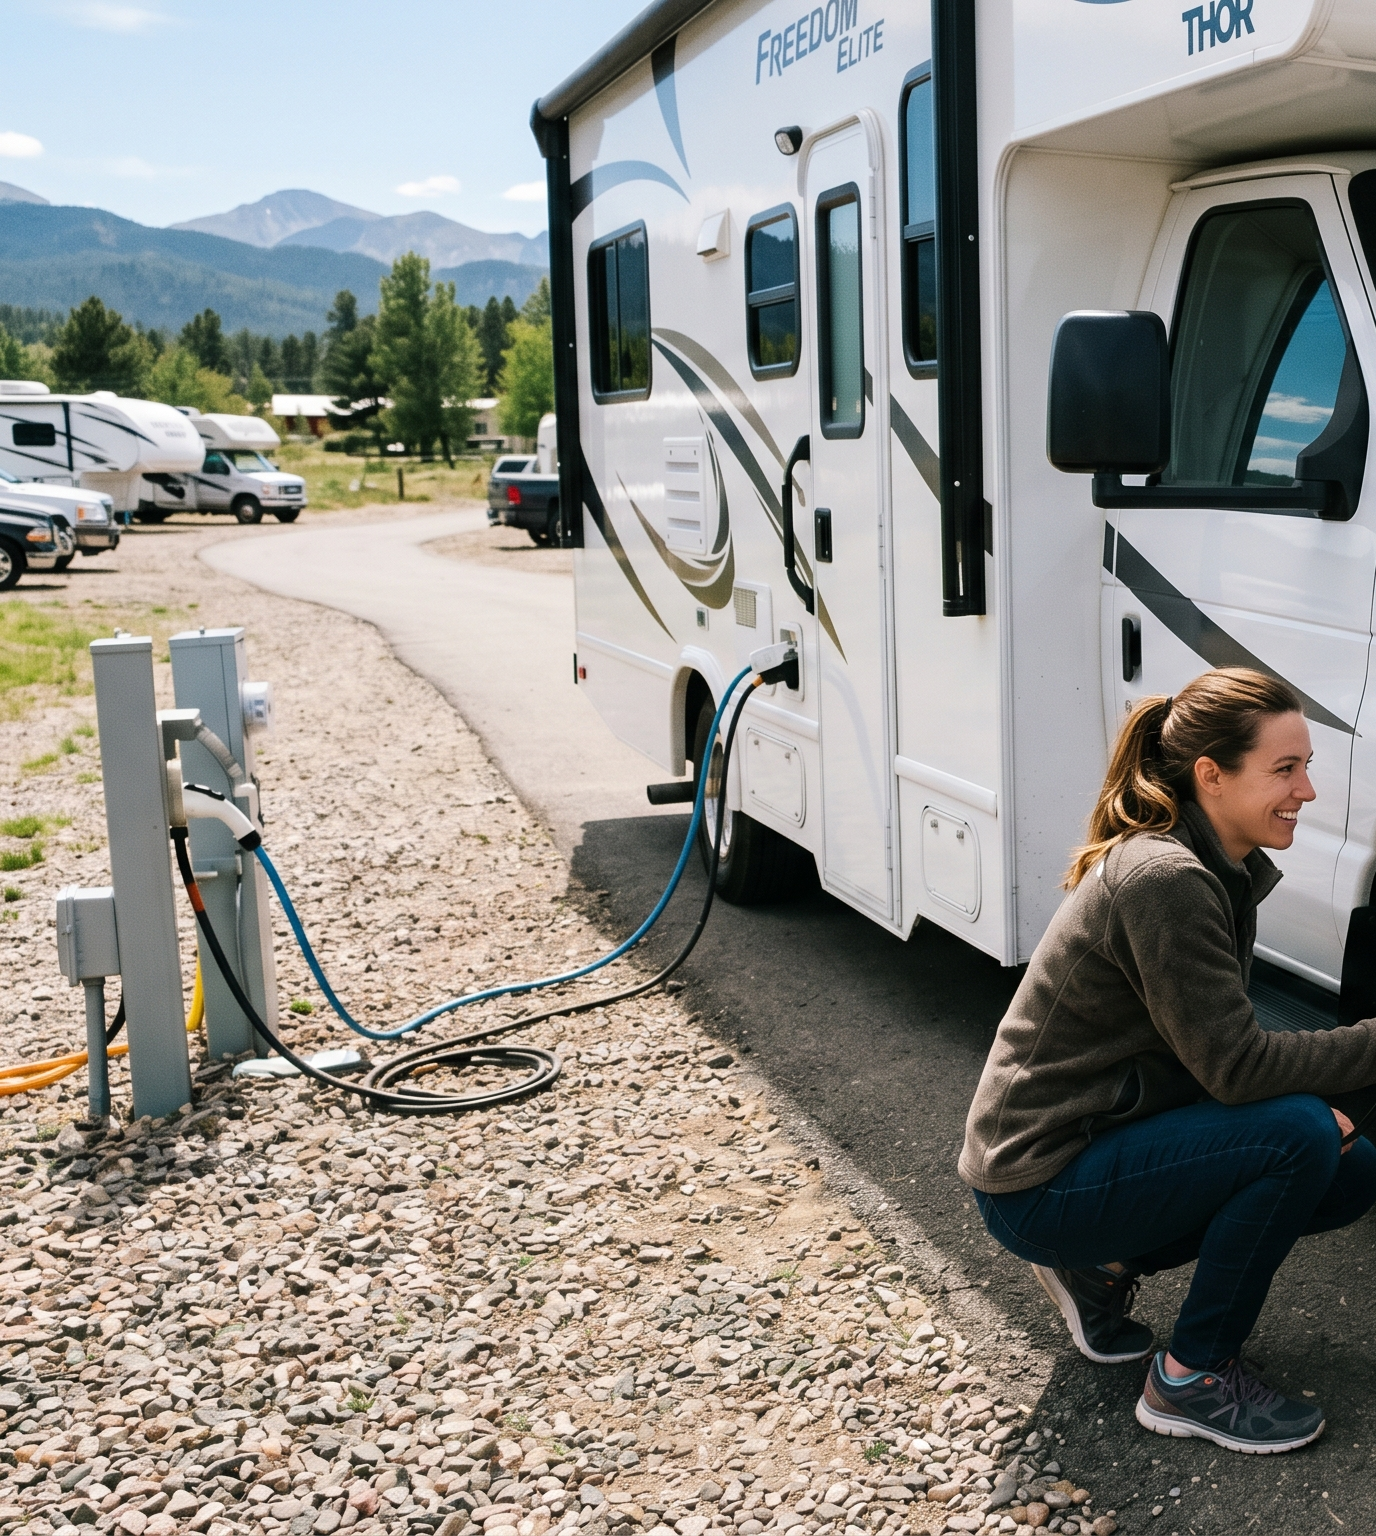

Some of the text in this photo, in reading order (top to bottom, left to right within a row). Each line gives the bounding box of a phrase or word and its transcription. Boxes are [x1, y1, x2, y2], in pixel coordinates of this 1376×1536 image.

[756, 0, 858, 85] FREEDOM
[837, 18, 885, 74] ELITE
[1182, 0, 1255, 56] THOR
